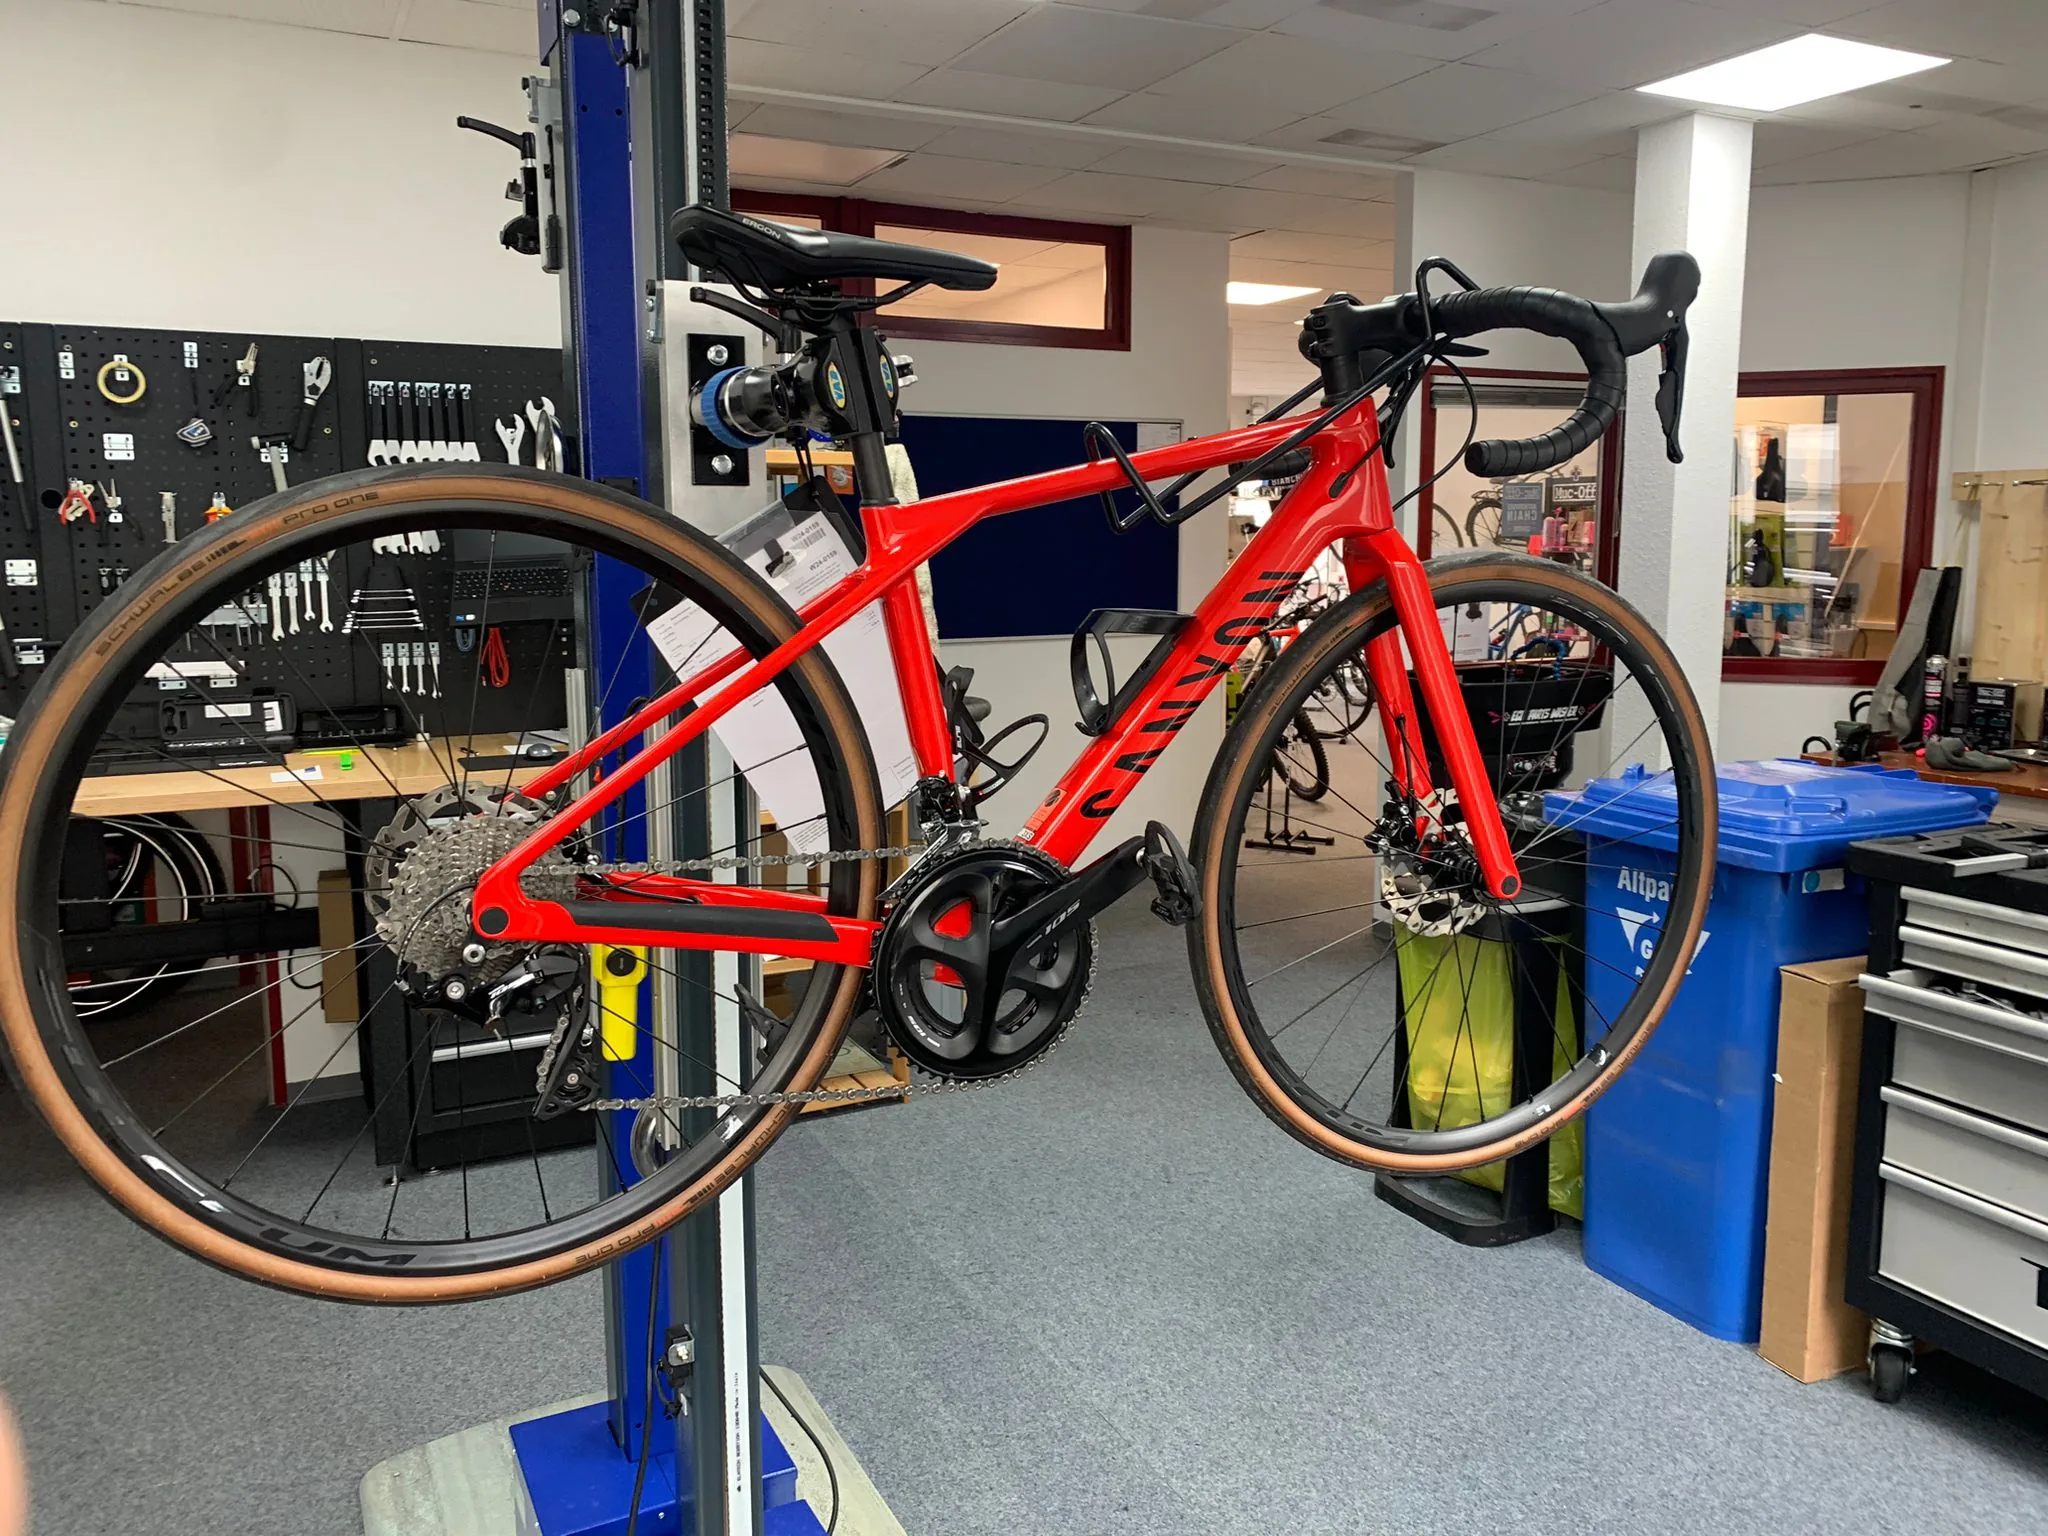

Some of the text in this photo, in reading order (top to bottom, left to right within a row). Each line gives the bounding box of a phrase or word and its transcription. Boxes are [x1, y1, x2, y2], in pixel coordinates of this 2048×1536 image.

[742, 217, 781, 240] ERGON
[1555, 484, 1597, 499] Muc-Off
[95, 562, 208, 658] SCHWALBE
[1080, 570, 1306, 820] CANYON
[1617, 865, 1674, 903] Altpa
[1045, 899, 1080, 935] 105
